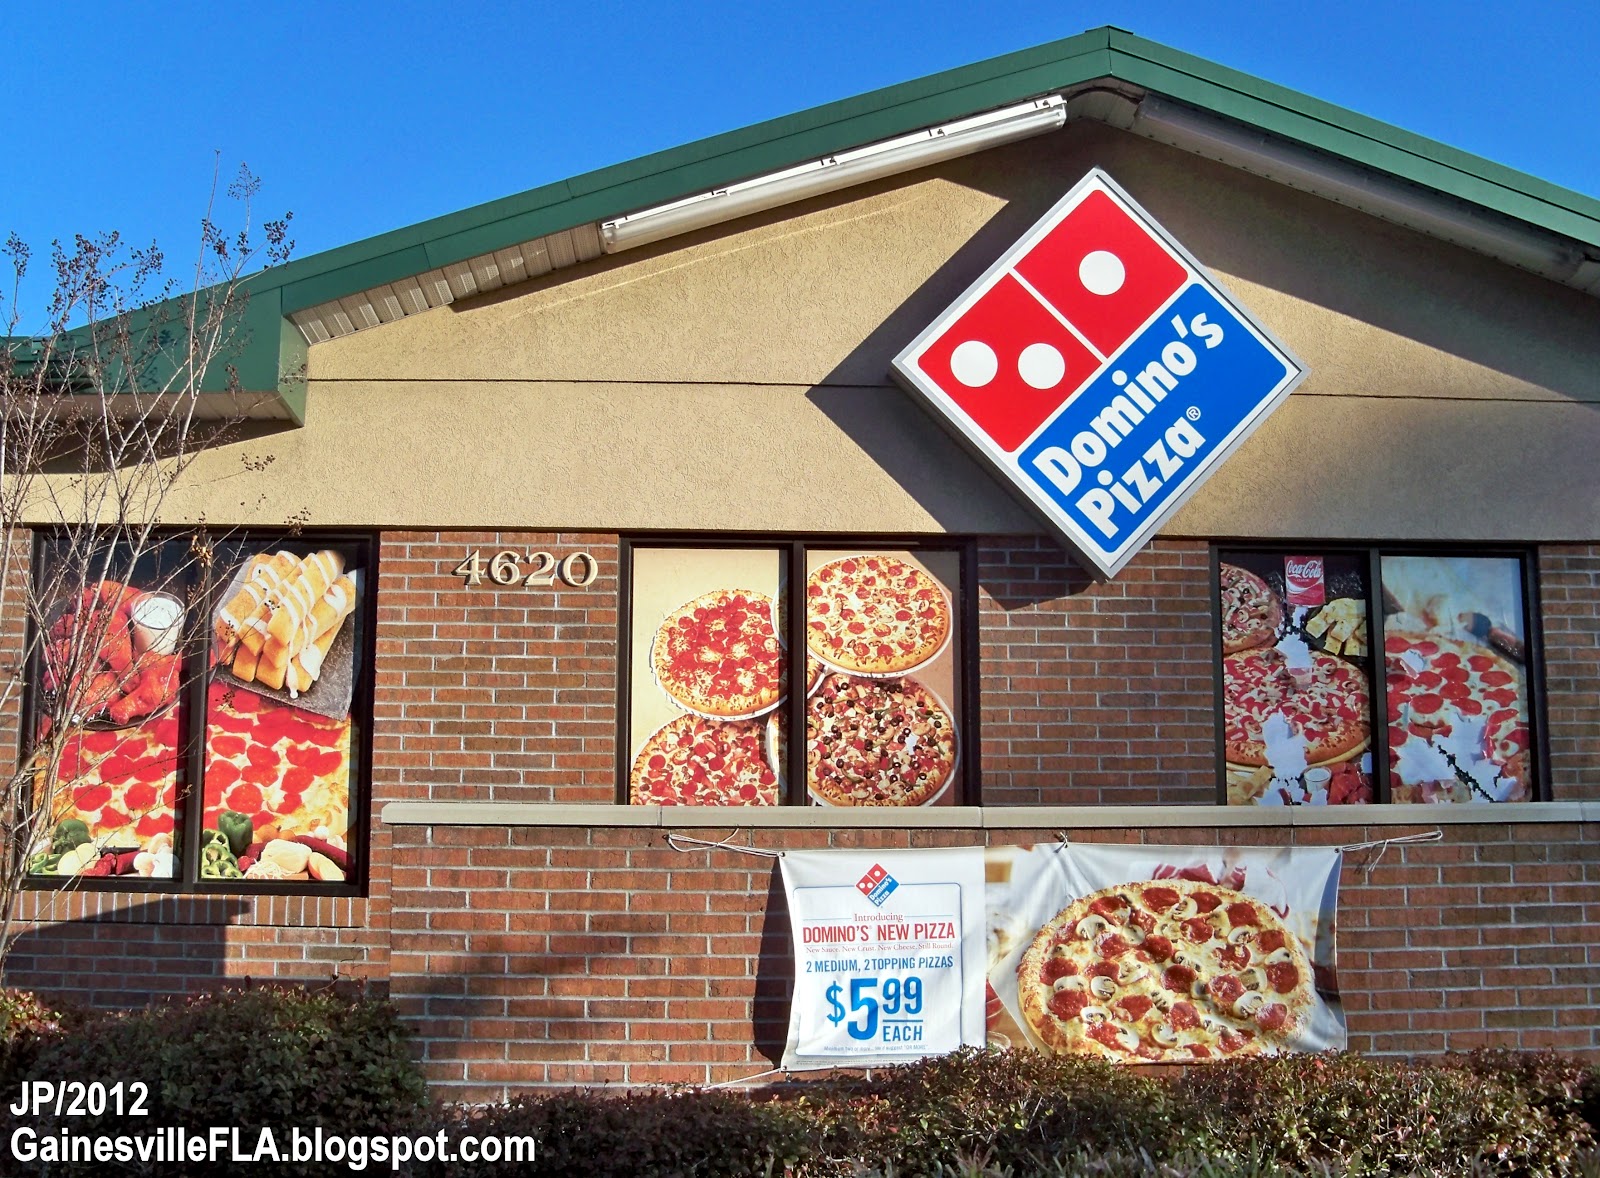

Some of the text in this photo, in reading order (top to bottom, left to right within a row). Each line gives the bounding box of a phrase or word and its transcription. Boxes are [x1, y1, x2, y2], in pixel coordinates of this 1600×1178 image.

[1032, 312, 1224, 496] Domino's
[451, 550, 598, 587] 4620
[869, 877, 892, 900] Domino's
[874, 890, 890, 906] Pizza
[854, 913, 903, 922] Introducing
[803, 922, 956, 943] DOMINO'S NEW PIZZA
[806, 961, 812, 973] 2
[815, 959, 861, 973] MEDIUM,
[872, 957, 915, 971] TOPPING
[919, 955, 954, 969] PIZZAS
[883, 1025, 922, 1042] EACH
